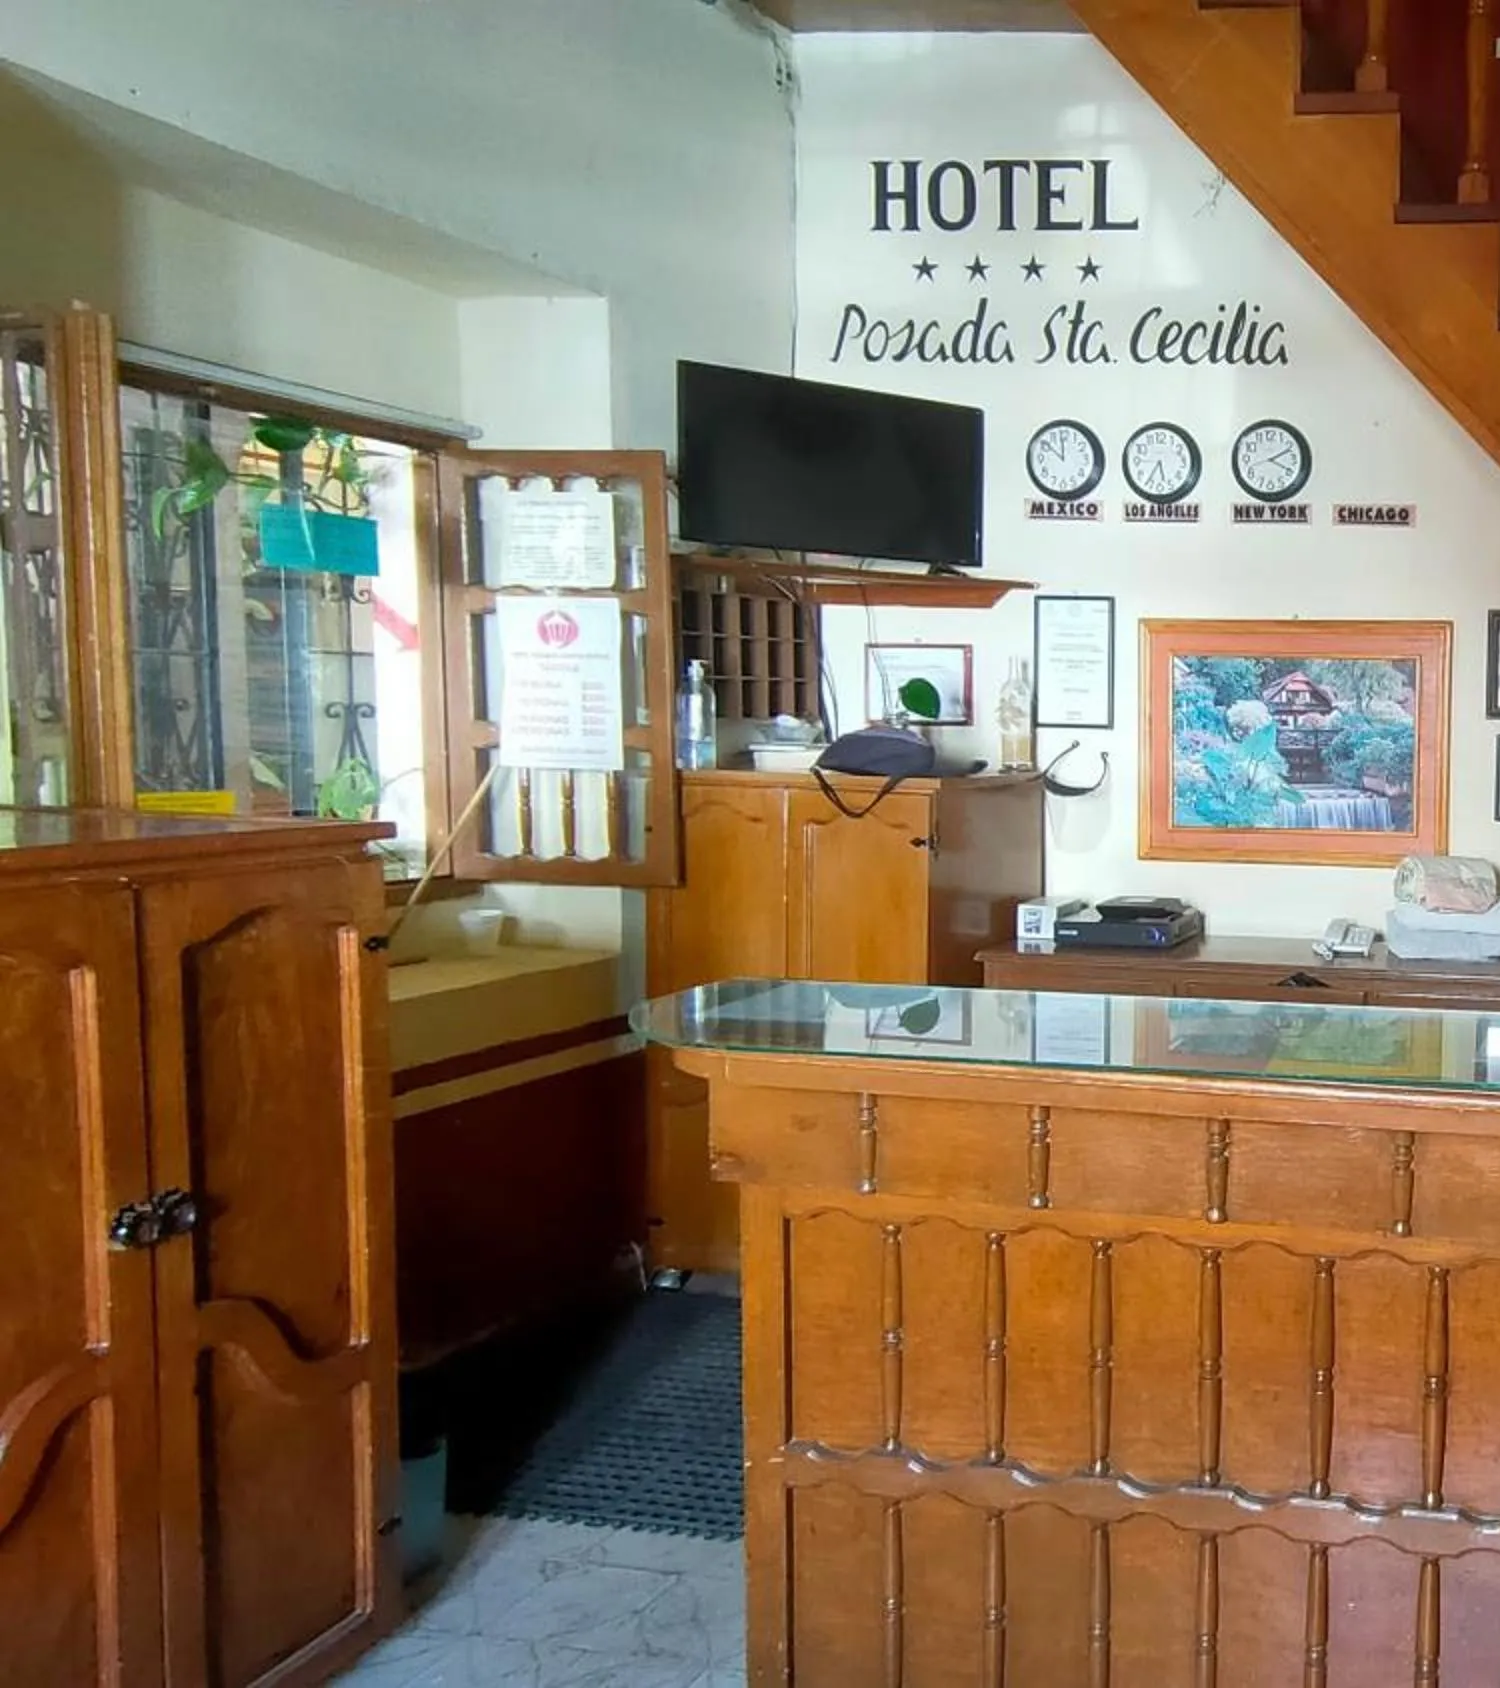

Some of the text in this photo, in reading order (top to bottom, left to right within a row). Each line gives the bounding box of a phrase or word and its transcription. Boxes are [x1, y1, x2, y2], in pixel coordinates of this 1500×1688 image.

[870, 159, 1139, 231] HOTEL
[829, 297, 1289, 366] Posada Sta. Cecilia
[1030, 501, 1099, 516] MEXICO
[1124, 503, 1199, 519] LOS ANGELES
[1233, 503, 1307, 519] NEW YORK
[1337, 506, 1409, 521] CHICAGO
